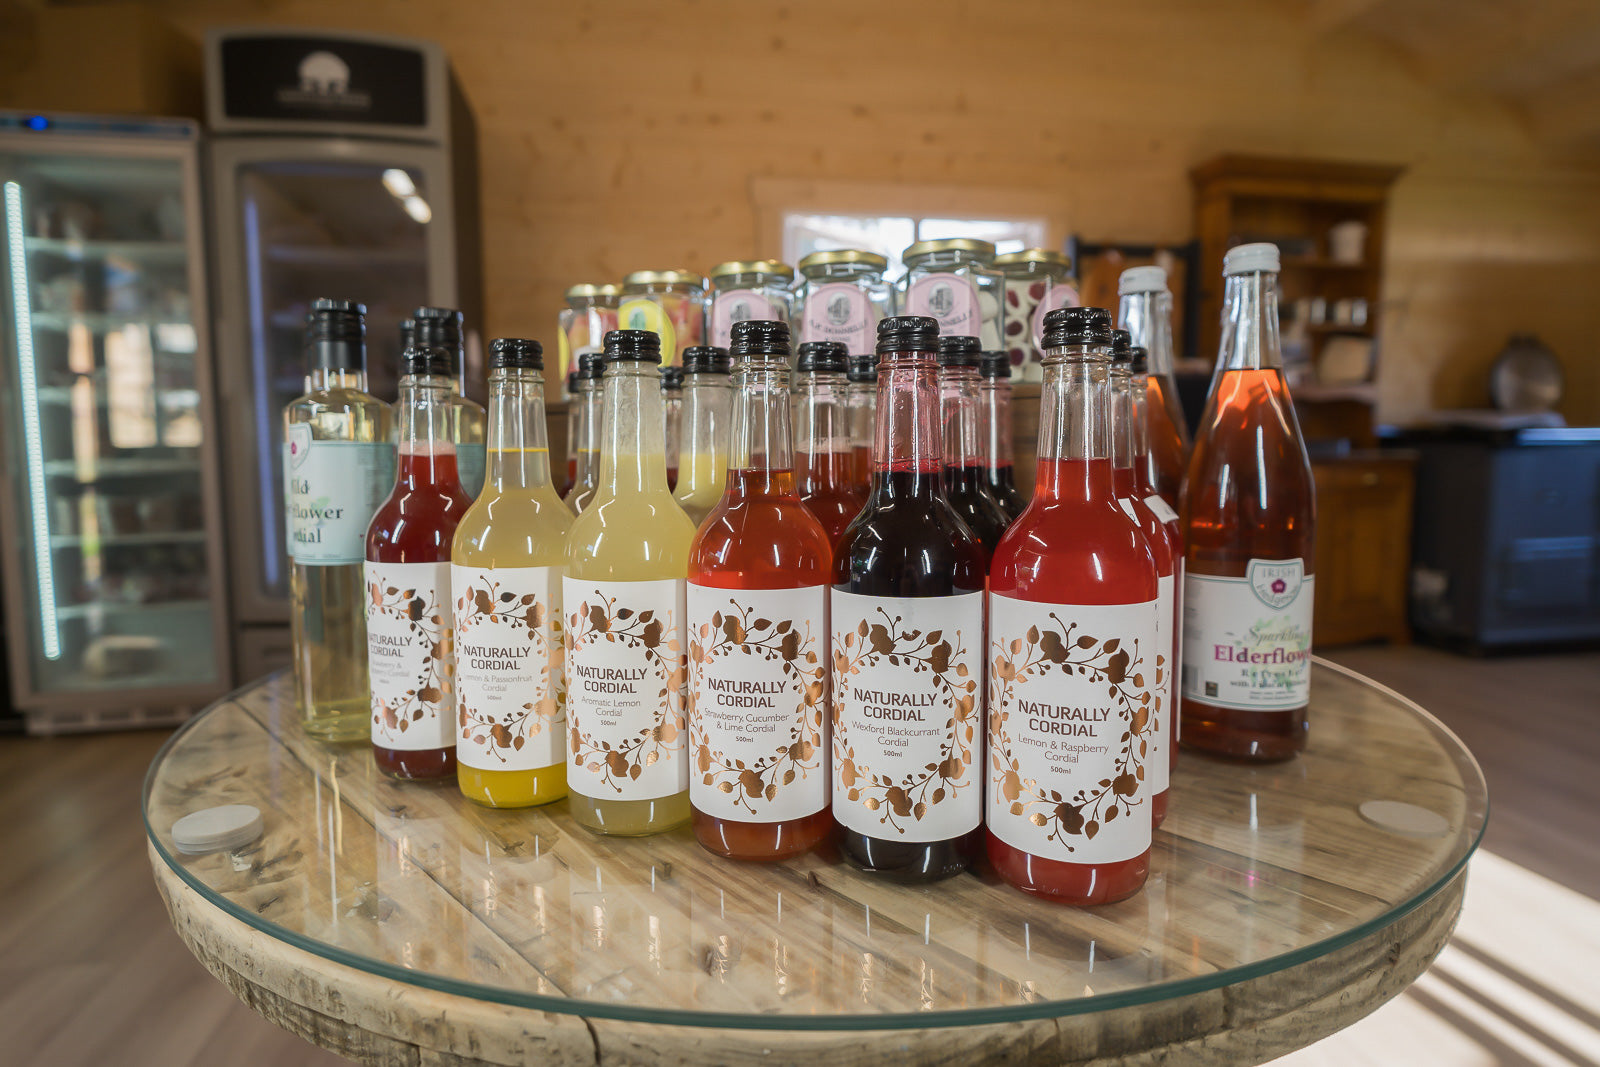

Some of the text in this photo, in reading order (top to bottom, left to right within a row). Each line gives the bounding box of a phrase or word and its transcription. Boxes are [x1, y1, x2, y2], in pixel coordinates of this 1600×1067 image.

[1263, 568, 1295, 578] IRISH
[371, 645, 404, 657] CORDIAL
[464, 645, 531, 658] NATURALLY
[1214, 644, 1312, 664] Elderflowe
[471, 659, 521, 670] CORDIAL
[577, 665, 648, 681] NATURALLY
[584, 680, 637, 694] CORDIAL
[708, 677, 787, 694] NATURALLY
[581, 696, 641, 708] Aromatic Lemon
[717, 693, 776, 708] CORDIAL
[854, 687, 938, 707] NATURALLY
[595, 708, 623, 717] Cordial
[863, 705, 926, 722] CORDIAL
[1018, 699, 1111, 722] NATURALLY
[745, 713, 790, 723] Cucumber
[716, 721, 776, 733] & Lime Cordial
[851, 720, 940, 737] Wexford Blackcurrant
[1029, 718, 1098, 737] CORDIAL
[877, 736, 909, 747] Cordial
[1018, 733, 1110, 756] Lemon & Raspberry
[883, 749, 903, 757] 500ml
[1044, 750, 1079, 764] Cordial
[1050, 765, 1072, 774] 500ml
